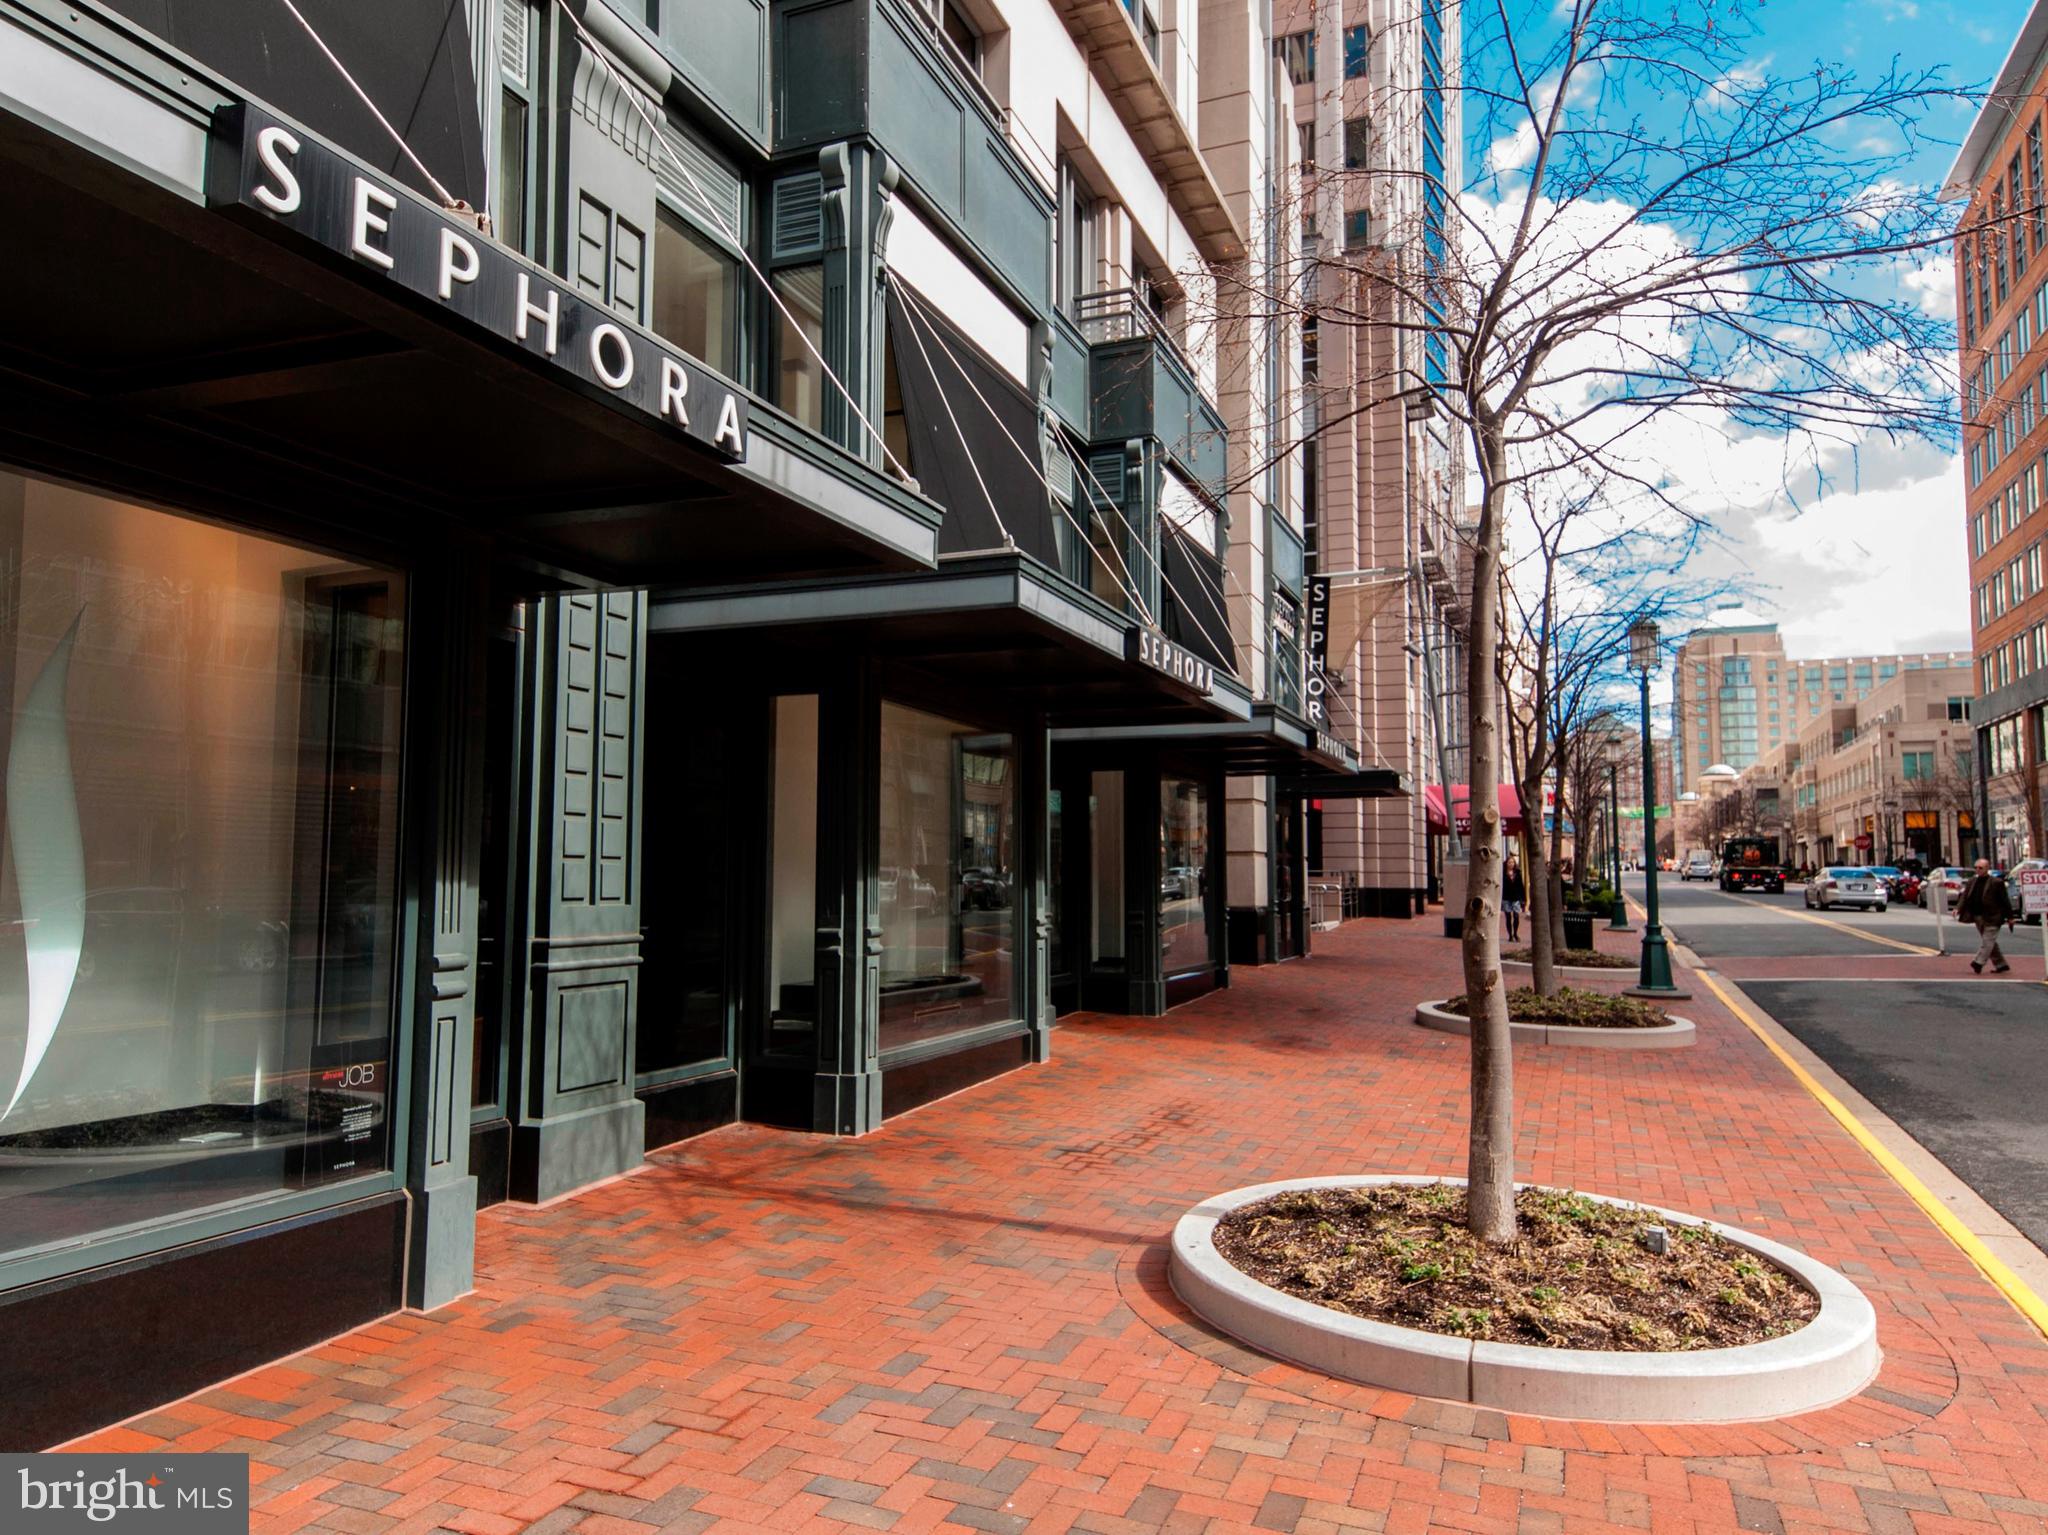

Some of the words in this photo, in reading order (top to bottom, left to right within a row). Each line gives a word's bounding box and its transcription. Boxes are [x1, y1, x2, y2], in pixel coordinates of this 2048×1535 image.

[251, 126, 742, 453] SEPHORA
[1141, 631, 1214, 692] SEPHORA
[1307, 583, 1325, 724] SEPHOR
[2022, 872, 2048, 884] STO
[338, 1063, 375, 1088] JOB
